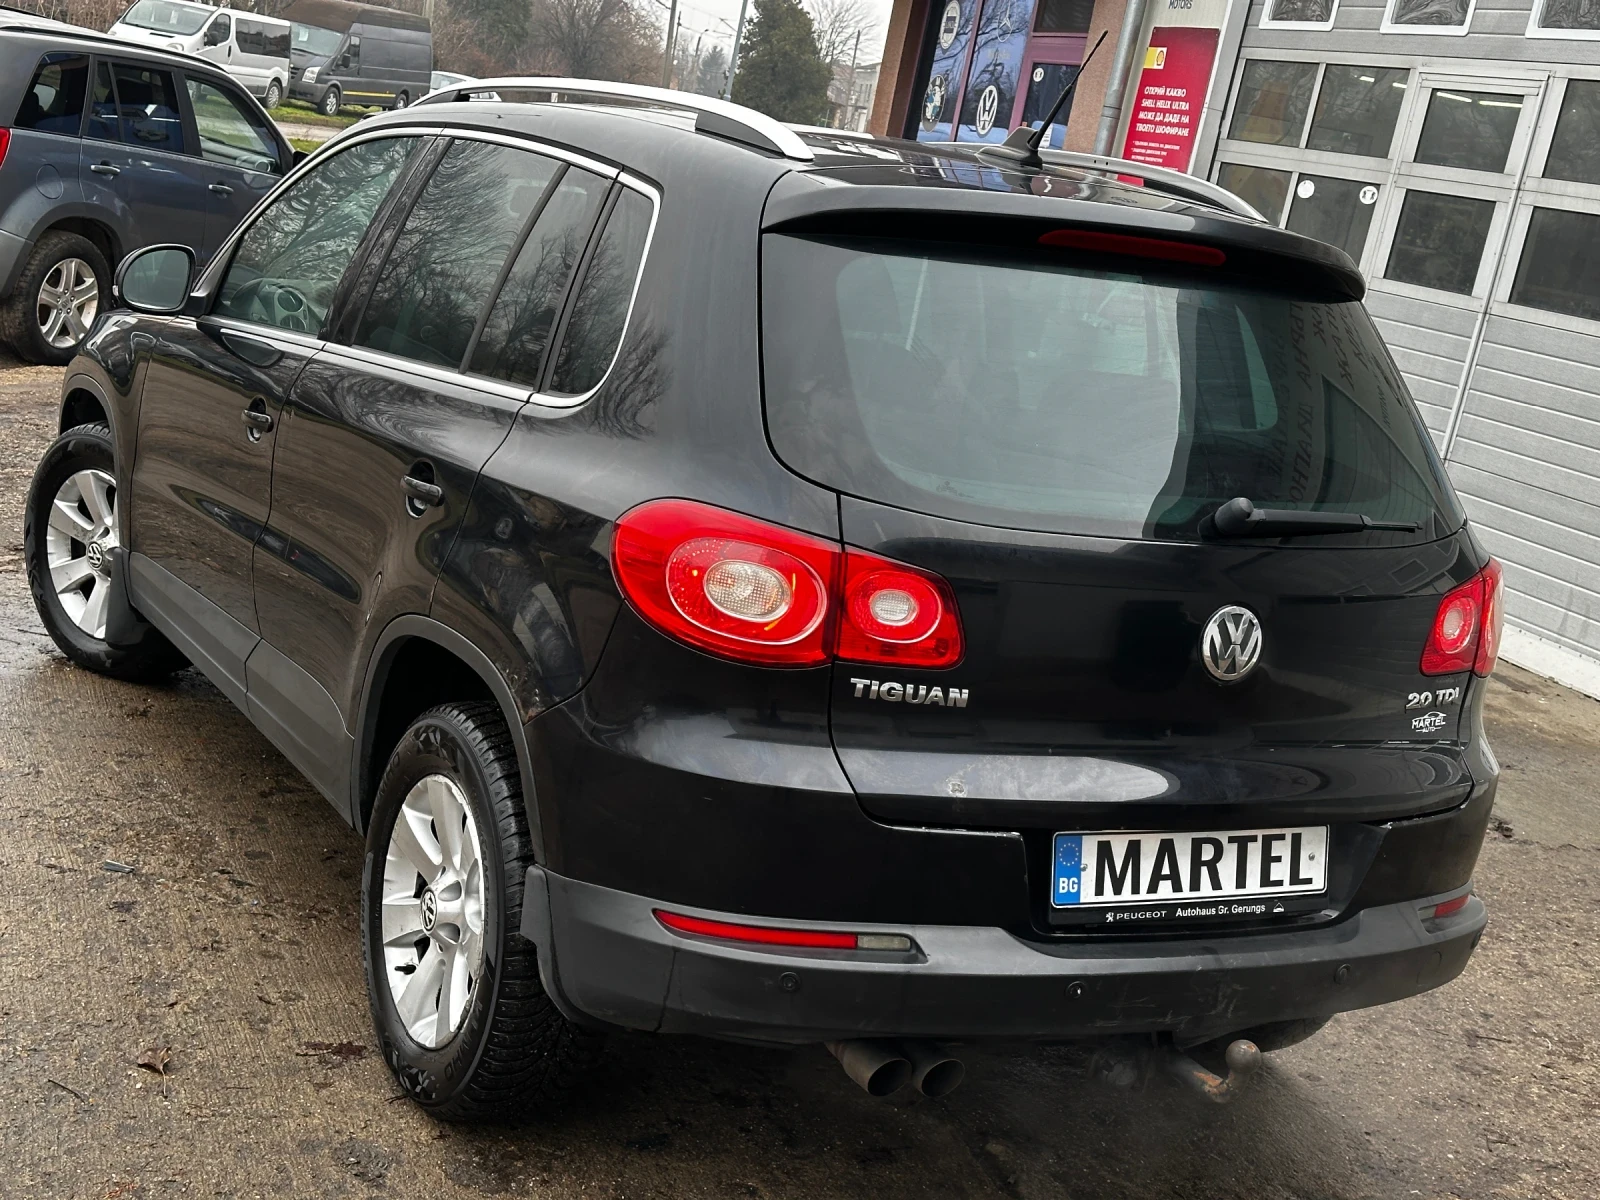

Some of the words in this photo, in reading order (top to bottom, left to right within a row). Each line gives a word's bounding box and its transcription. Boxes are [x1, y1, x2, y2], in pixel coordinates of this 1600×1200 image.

[1165, 87, 1187, 97] КАКВО
[1141, 98, 1156, 107] SHELL
[1156, 100, 1172, 109] HELIX
[1172, 101, 1190, 110] ULTRA
[1138, 111, 1155, 120] МОЖЕ
[1155, 112, 1164, 122] ДА
[1164, 113, 1181, 123] ДАДЕ
[1181, 115, 1190, 124] НА
[1155, 125, 1190, 137] ШОФИРАНЕ
[849, 677, 970, 708] TIGUAN
[1435, 686, 1460, 706] TDI
[1411, 716, 1447, 730] MARTEL
[1058, 876, 1079, 894] BG
[1094, 832, 1313, 897] MARTEL
[1116, 910, 1168, 920] PEUGEOT
[1175, 906, 1216, 918] Autohaus
[1218, 905, 1230, 915] Gr.
[1231, 903, 1266, 916] Gerungs
